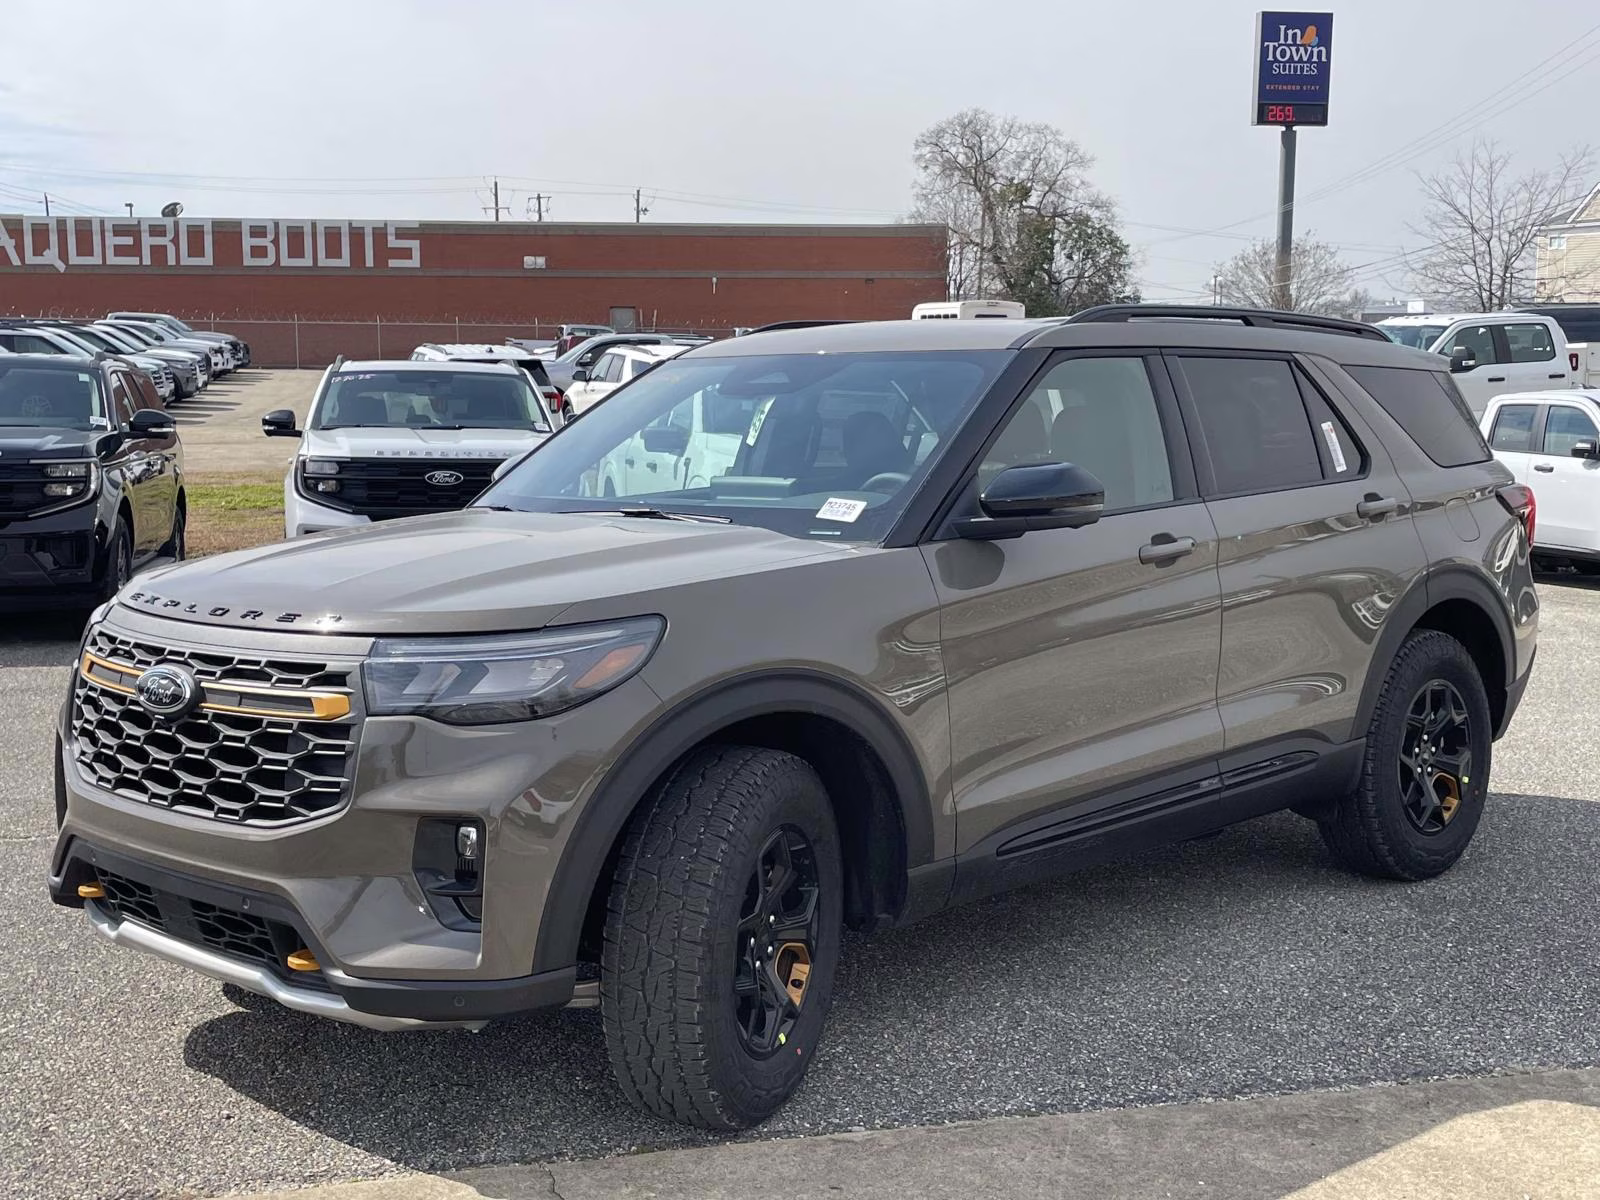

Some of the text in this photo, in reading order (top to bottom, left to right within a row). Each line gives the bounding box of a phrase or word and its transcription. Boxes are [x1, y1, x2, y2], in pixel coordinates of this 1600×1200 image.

[1278, 24, 1302, 45] In
[1272, 62, 1318, 75] SUITES
[241, 218, 421, 268] BOOTS
[431, 471, 457, 484] Ford
[142, 675, 178, 705] Ford
